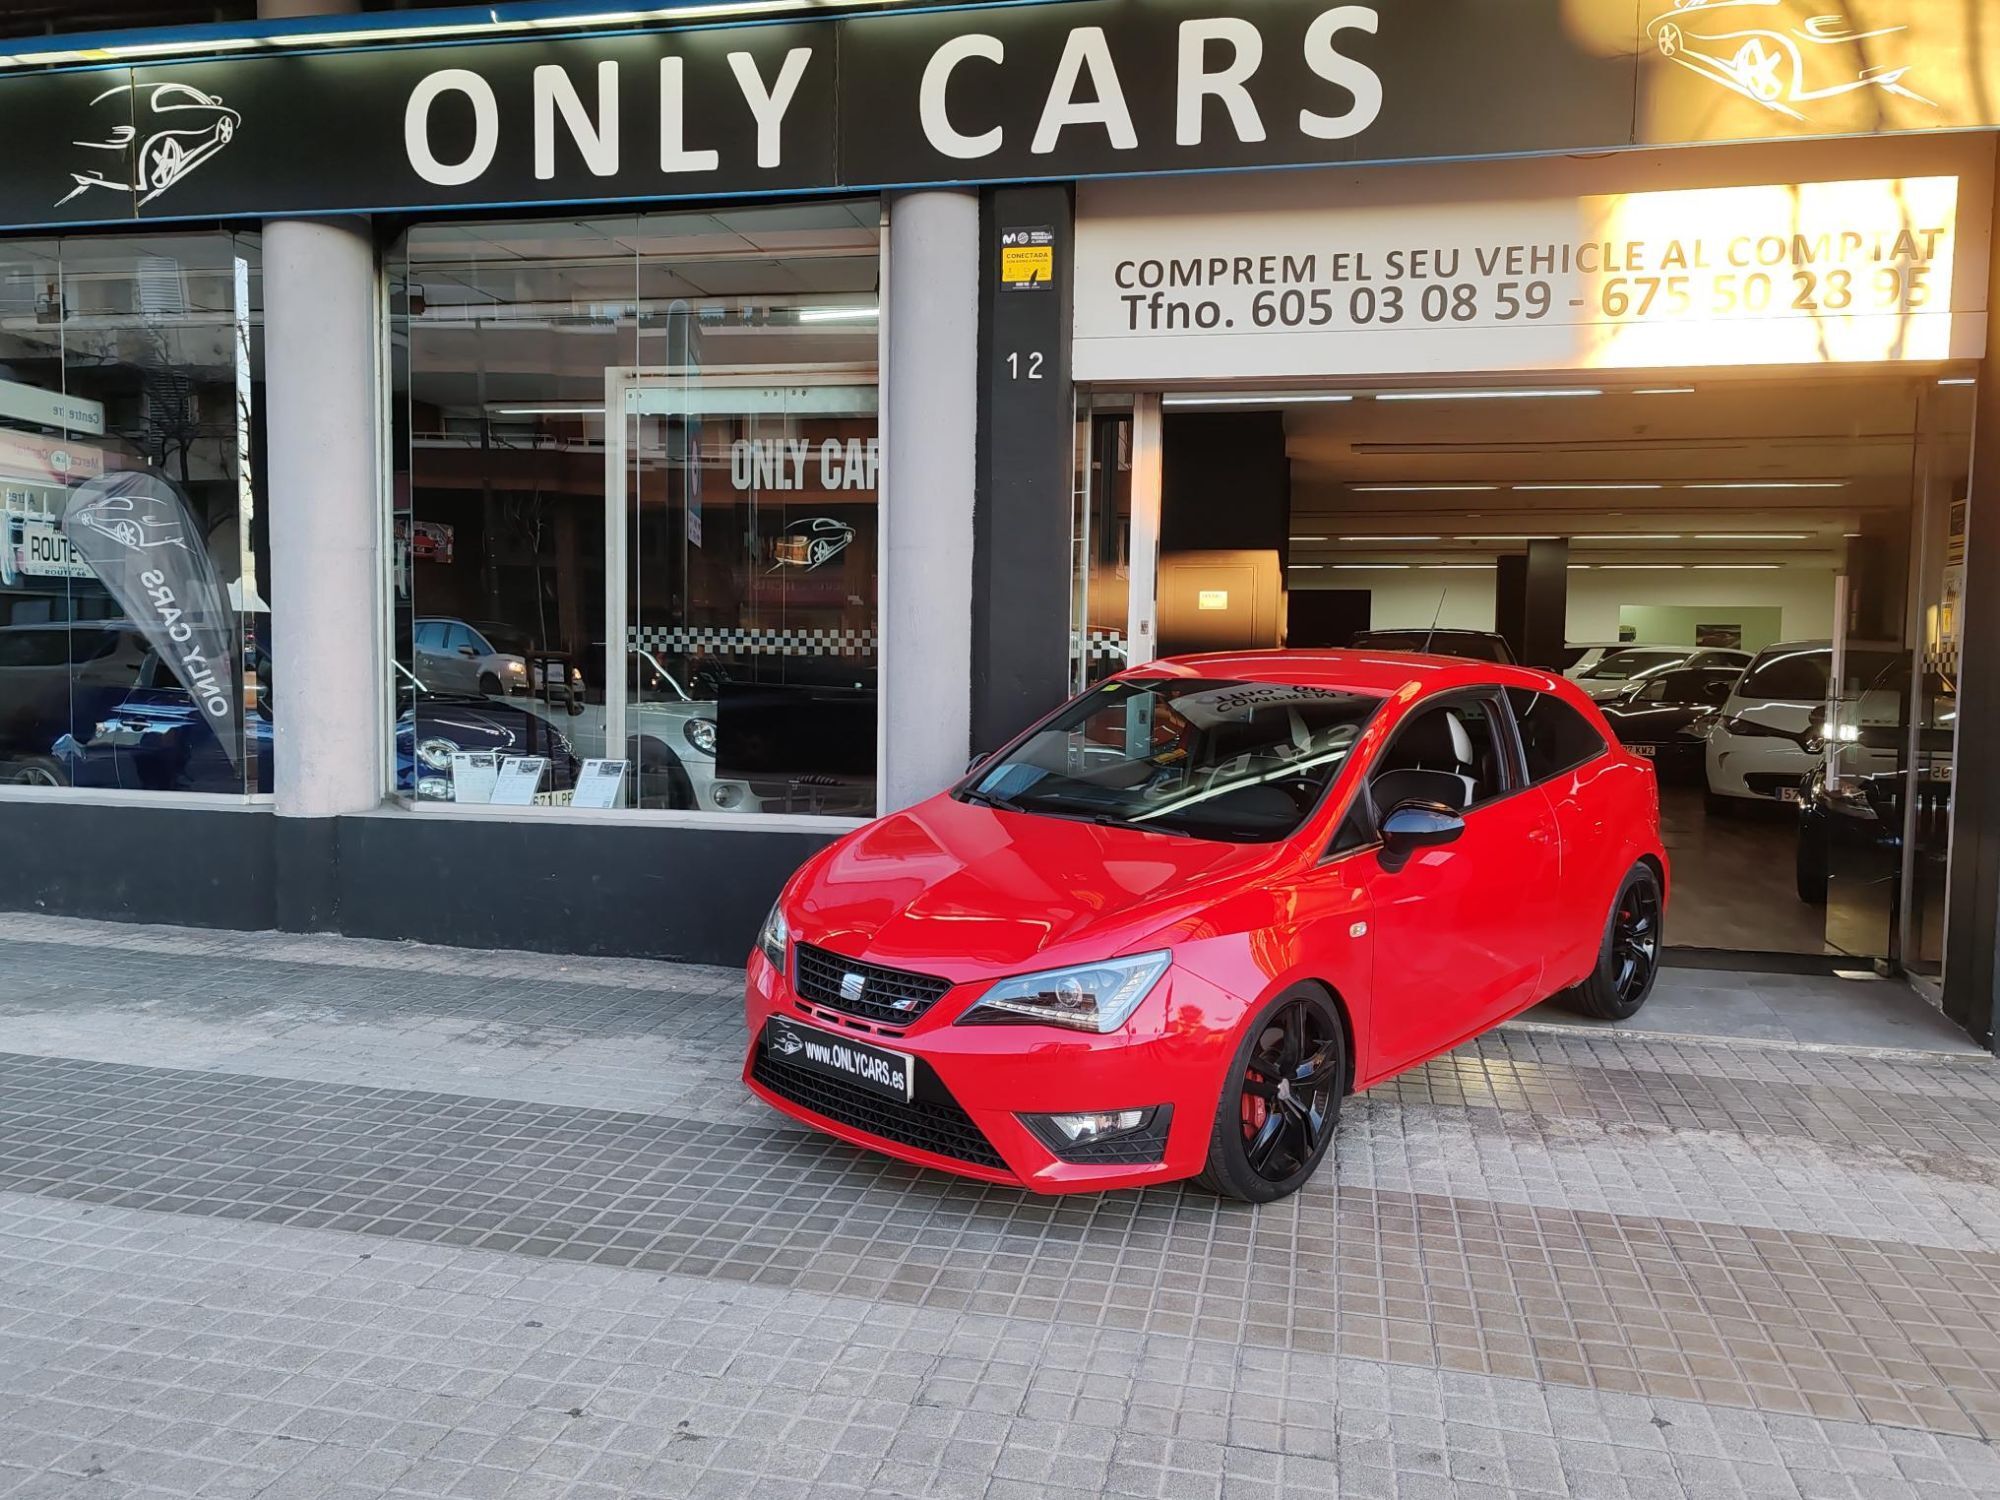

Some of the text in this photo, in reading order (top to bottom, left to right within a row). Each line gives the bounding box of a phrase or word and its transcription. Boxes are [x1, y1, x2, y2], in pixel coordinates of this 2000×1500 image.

[404, 5, 1383, 186] ONLY CARS
[1114, 254, 1316, 289] COMPREM
[1332, 253, 1372, 282] EL
[1385, 248, 1460, 280] SEU
[1475, 241, 1645, 277] VEHICLE
[1660, 239, 1710, 271] AL
[1120, 294, 1234, 330] Tfno.
[1252, 289, 1333, 327] 605
[1349, 285, 1404, 324] 03
[1421, 283, 1477, 322] 08
[1495, 280, 1551, 320] 59
[1602, 275, 1693, 317] 675
[1711, 273, 1772, 313] 50
[1791, 269, 1852, 310] 28
[1872, 266, 1932, 308] 95
[731, 438, 809, 490] ONLY
[31, 535, 77, 564] ROUTE
[804, 1040, 905, 1091] www.ONLYCARS.es
